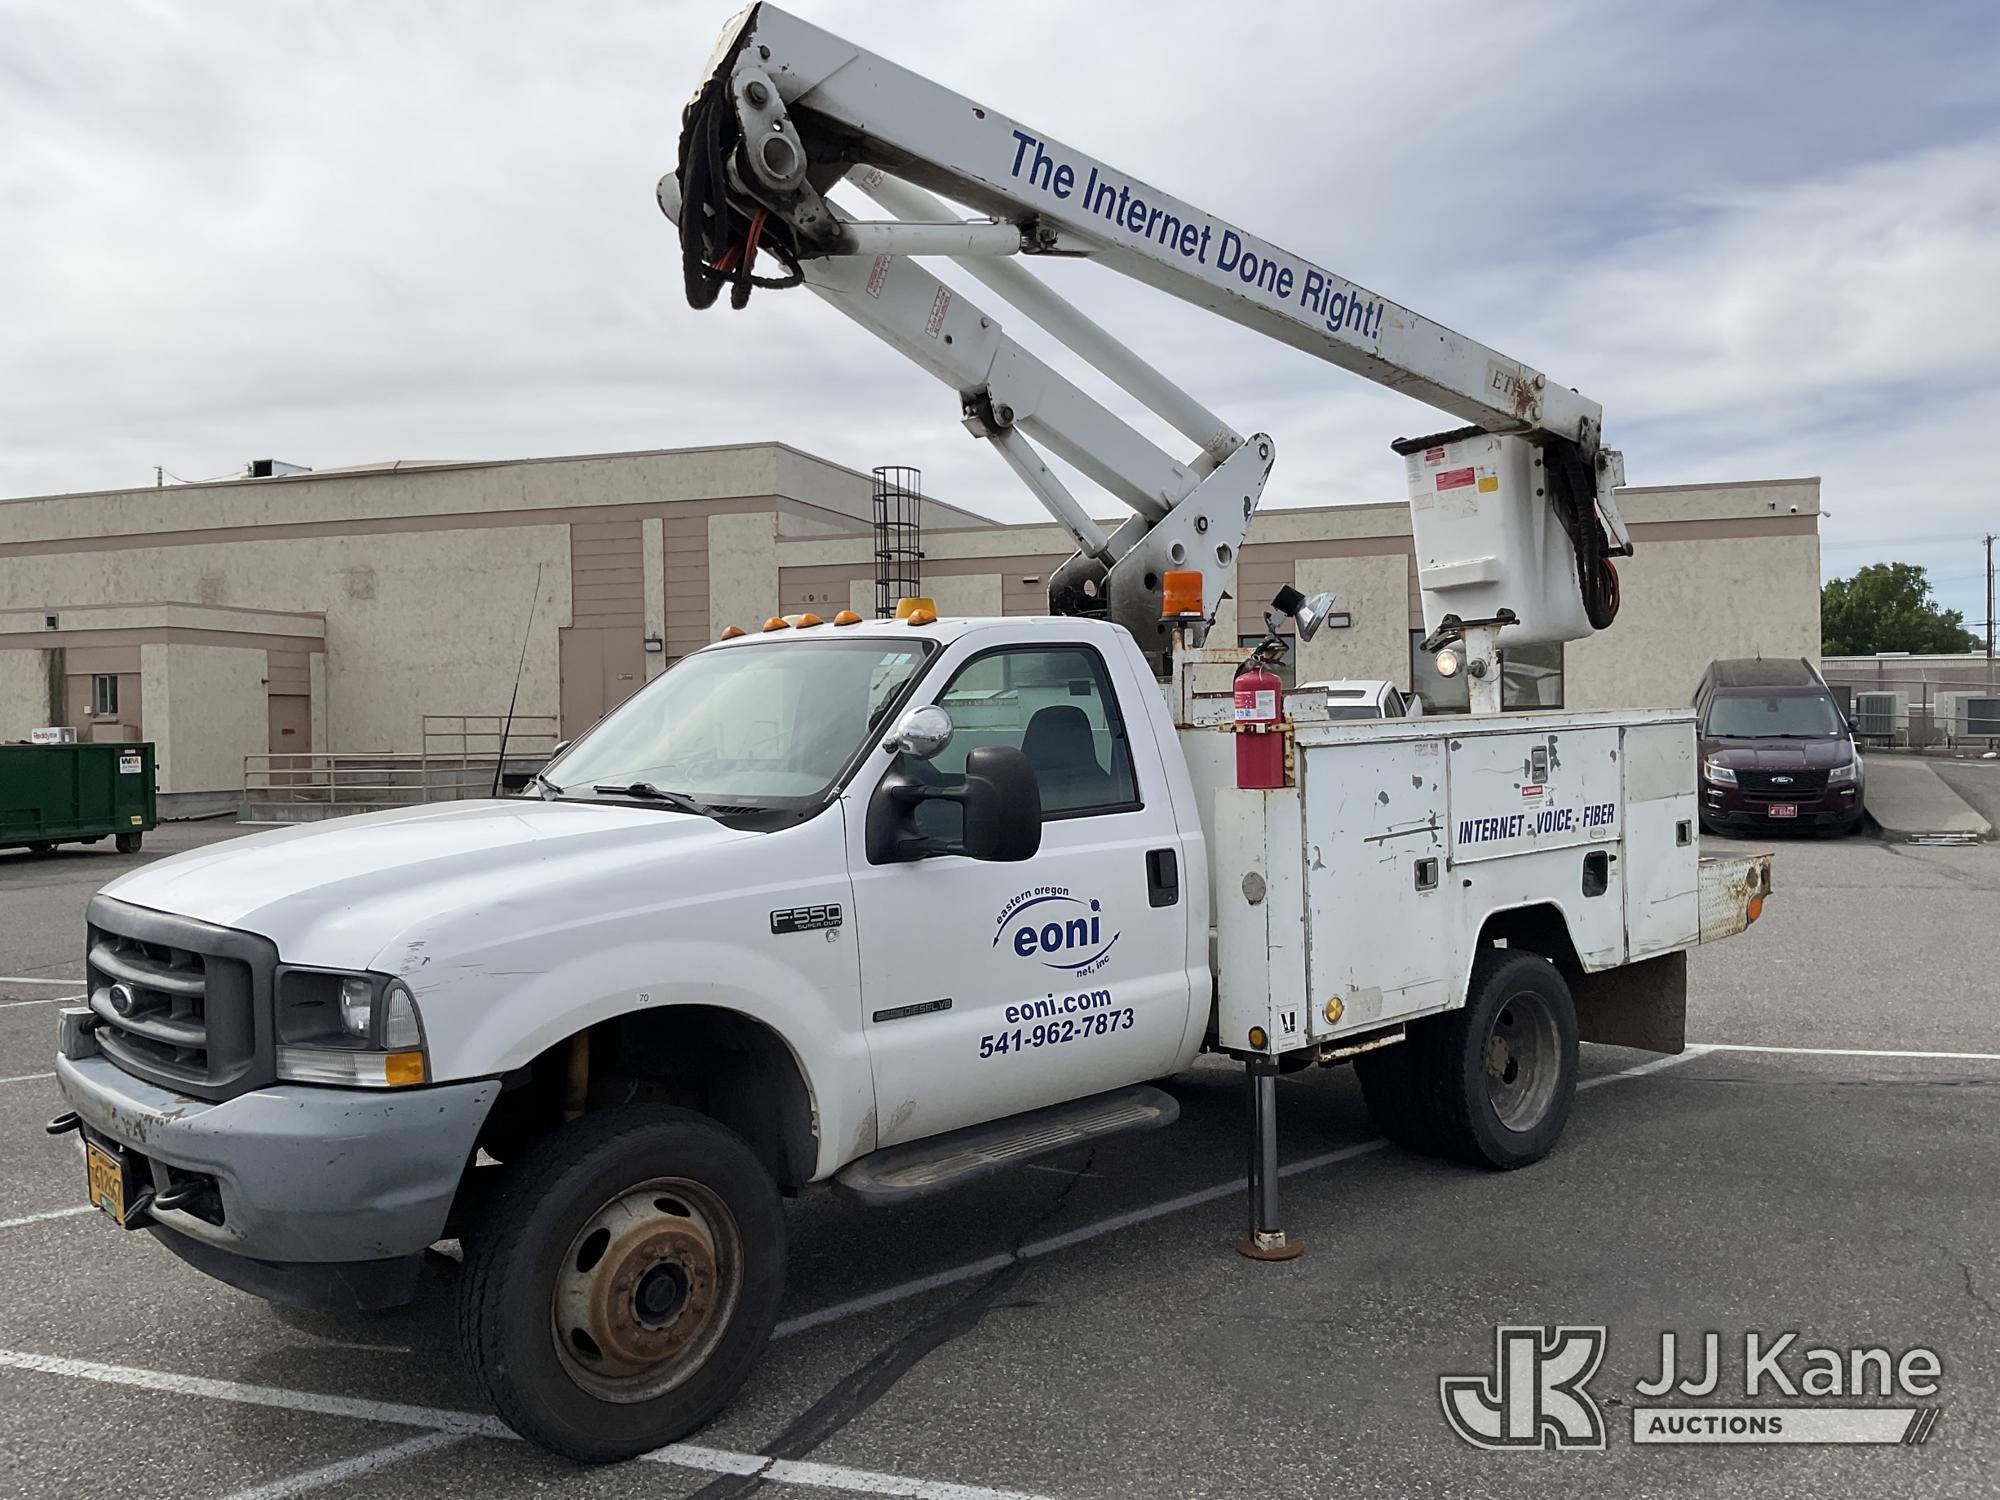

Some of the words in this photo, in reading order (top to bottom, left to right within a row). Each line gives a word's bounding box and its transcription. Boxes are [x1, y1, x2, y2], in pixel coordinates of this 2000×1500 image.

[1011, 129, 1074, 200] The
[1083, 168, 1211, 264] Internet
[1216, 230, 1294, 298] Done
[1299, 268, 1384, 339] Right!
[1458, 815, 1525, 844] INTERNET
[1537, 808, 1572, 834] VOICE
[1583, 803, 1615, 827] FIBER
[996, 889, 1032, 925] eastern
[1034, 886, 1069, 896] oregon
[1014, 899, 1101, 957] eoni
[1076, 966, 1095, 978] net,
[1096, 955, 1110, 969] inc
[639, 993, 649, 1002] 70
[904, 1003, 938, 1016] DIESEL
[1005, 989, 1111, 1024] eoni.com
[979, 1008, 1134, 1059] 541-962-7873
